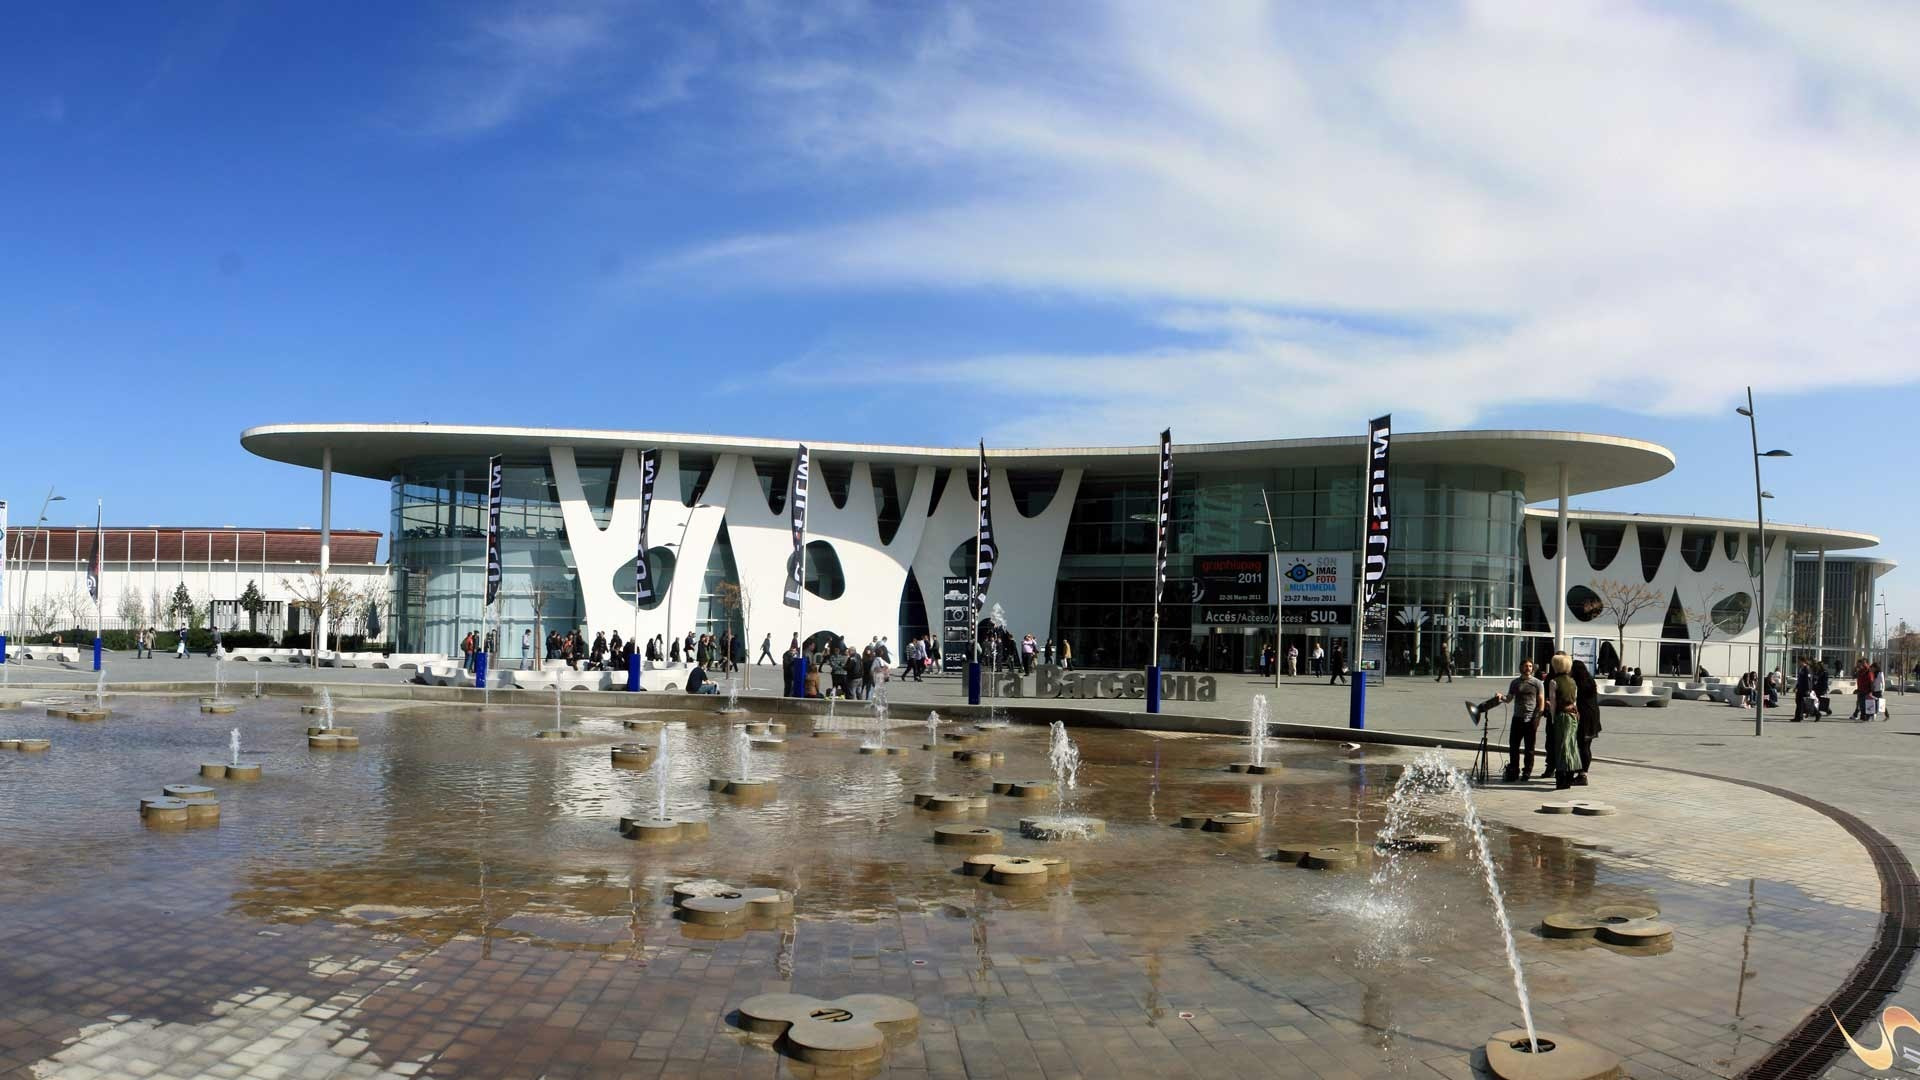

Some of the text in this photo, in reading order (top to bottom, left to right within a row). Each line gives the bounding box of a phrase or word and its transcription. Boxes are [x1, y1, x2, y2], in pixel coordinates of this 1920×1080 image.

[1316, 566, 1337, 575] IMAG
[1238, 572, 1263, 584] 2011
[1316, 575, 1337, 584] FOTO
[1310, 610, 1338, 623] SUD
[1036, 664, 1217, 702] Barceona
